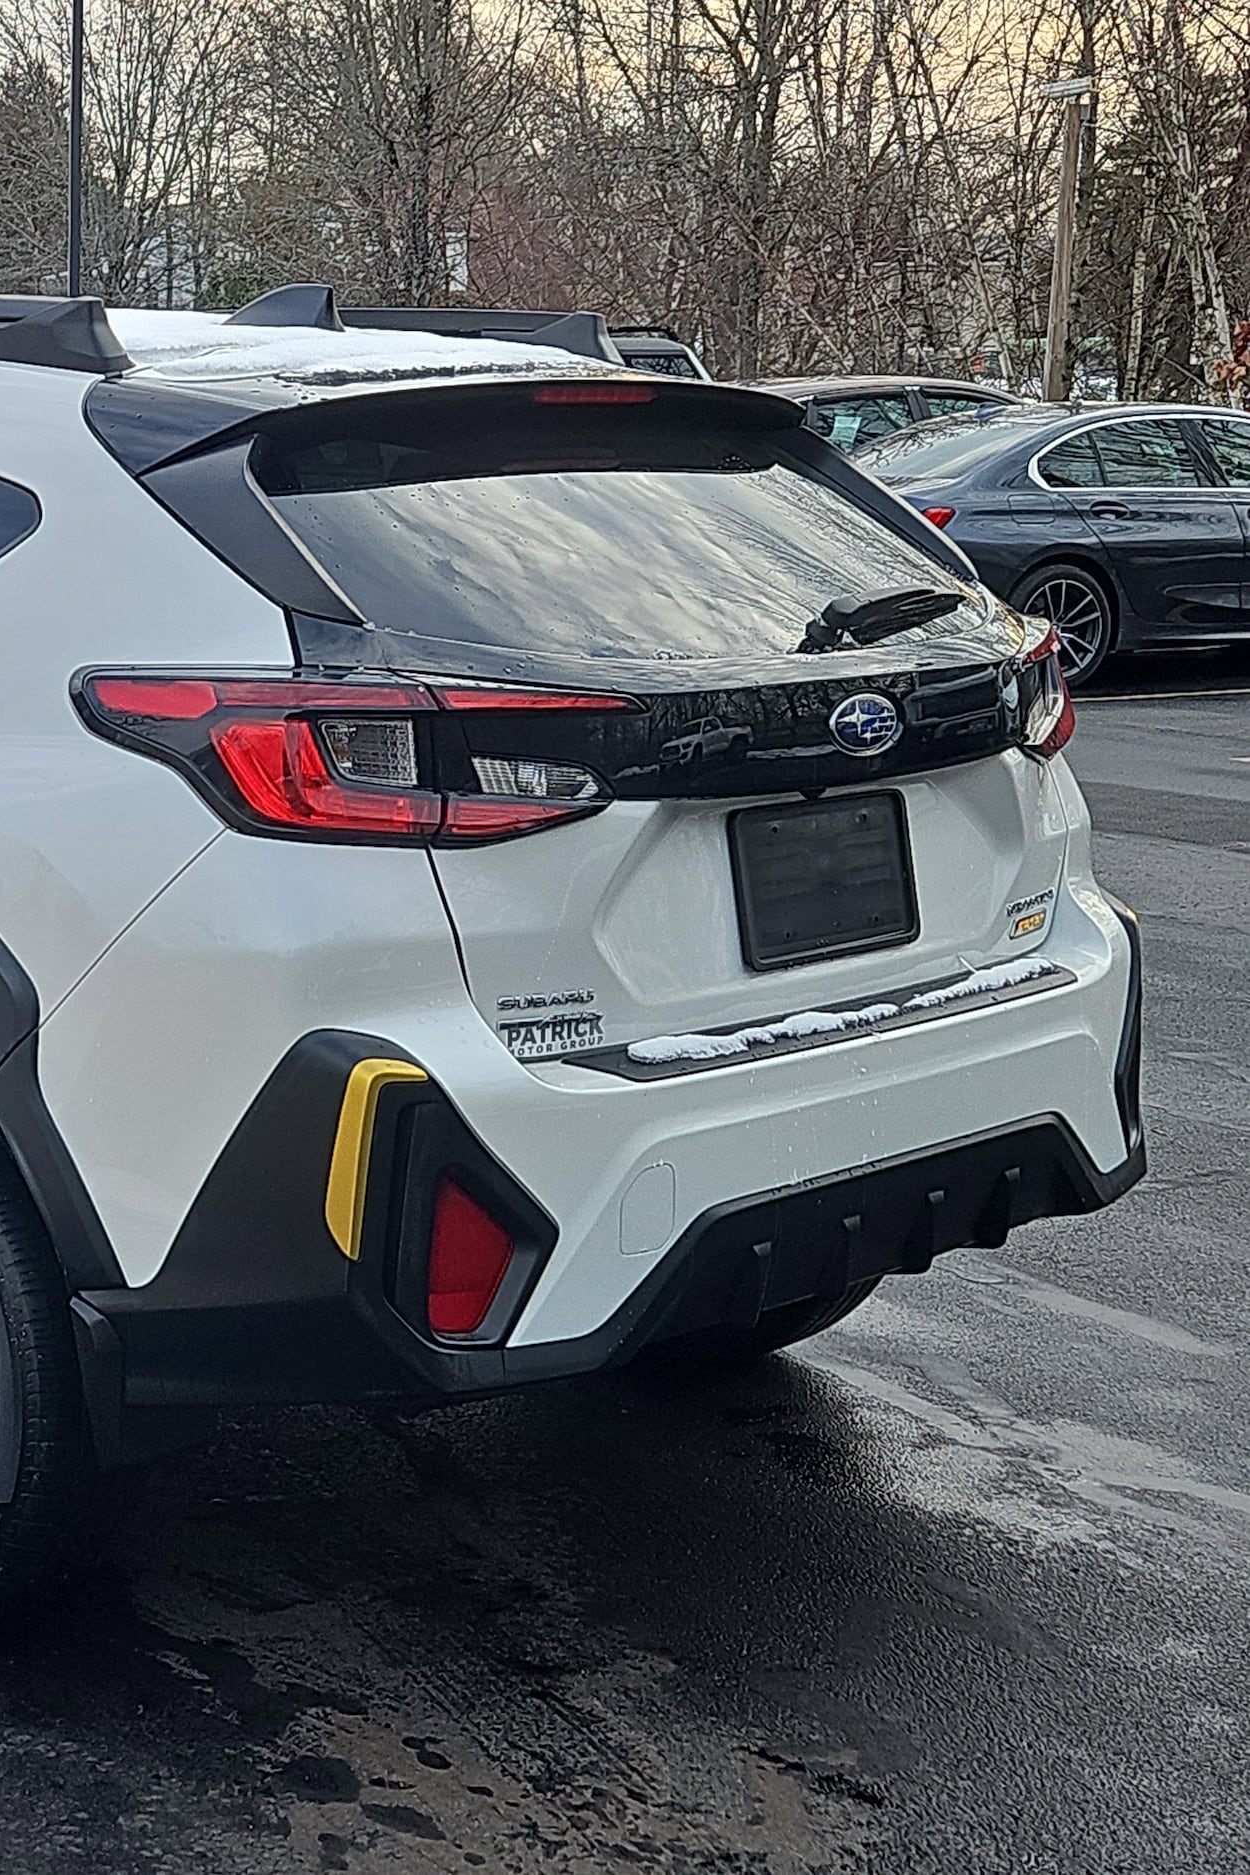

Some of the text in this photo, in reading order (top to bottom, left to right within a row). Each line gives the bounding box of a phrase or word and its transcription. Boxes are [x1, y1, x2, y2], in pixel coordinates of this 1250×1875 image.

[497, 989, 594, 1010] SUBARU
[506, 1020, 604, 1048] PATRICK
[560, 1035, 604, 1050] GROUP
